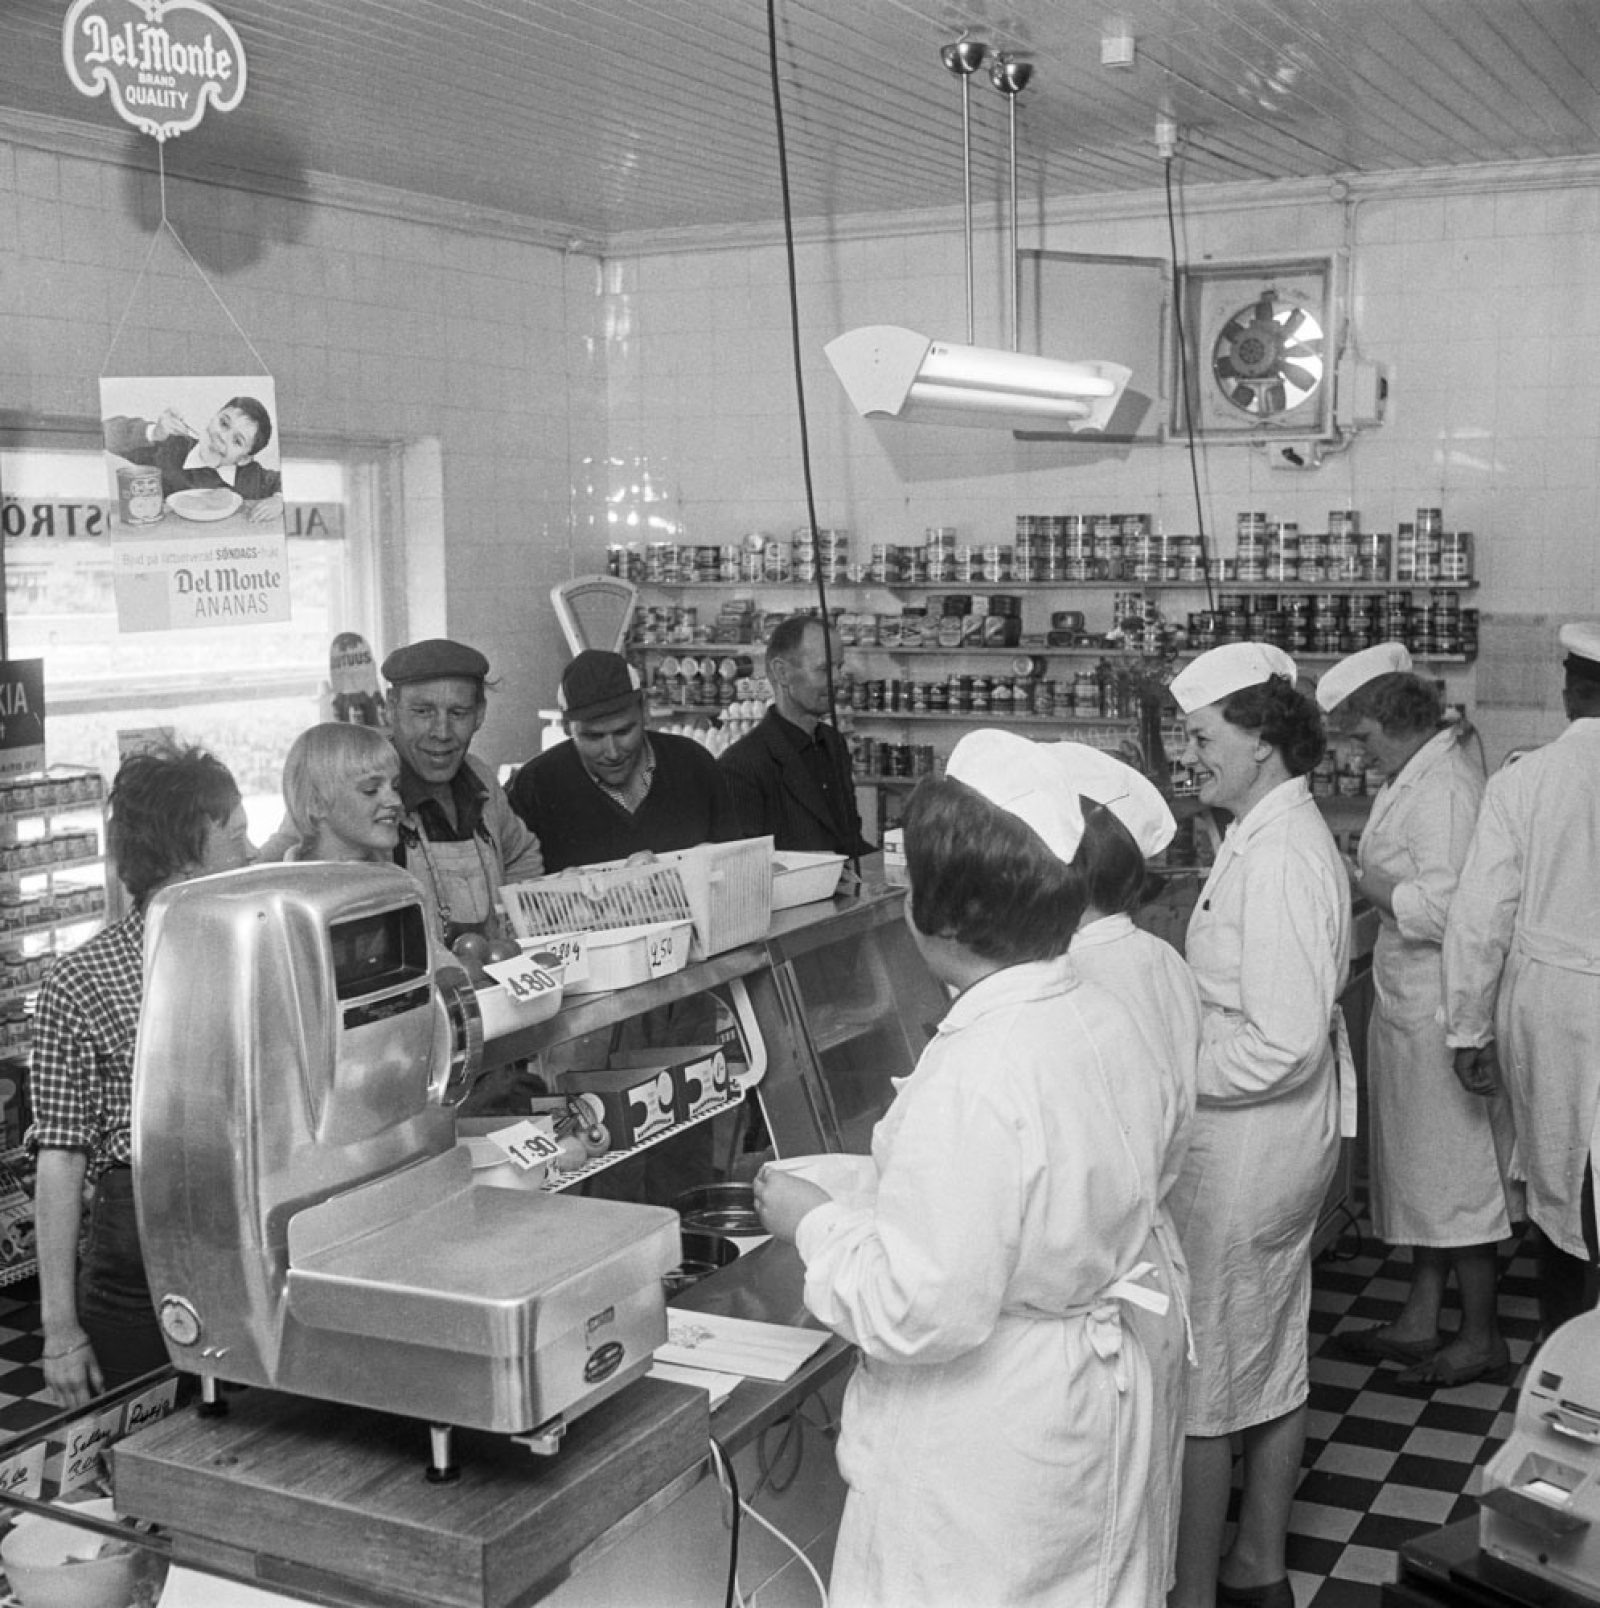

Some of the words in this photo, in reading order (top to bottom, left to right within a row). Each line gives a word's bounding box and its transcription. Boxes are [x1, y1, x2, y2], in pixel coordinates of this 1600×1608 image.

[82, 15, 140, 68] Del
[136, 24, 232, 80] Monte
[138, 72, 176, 87] BRAND
[125, 84, 189, 109] QUALITY
[173, 568, 213, 594] Del
[215, 567, 282, 592] Monte
[195, 592, 270, 618] ANANAS
